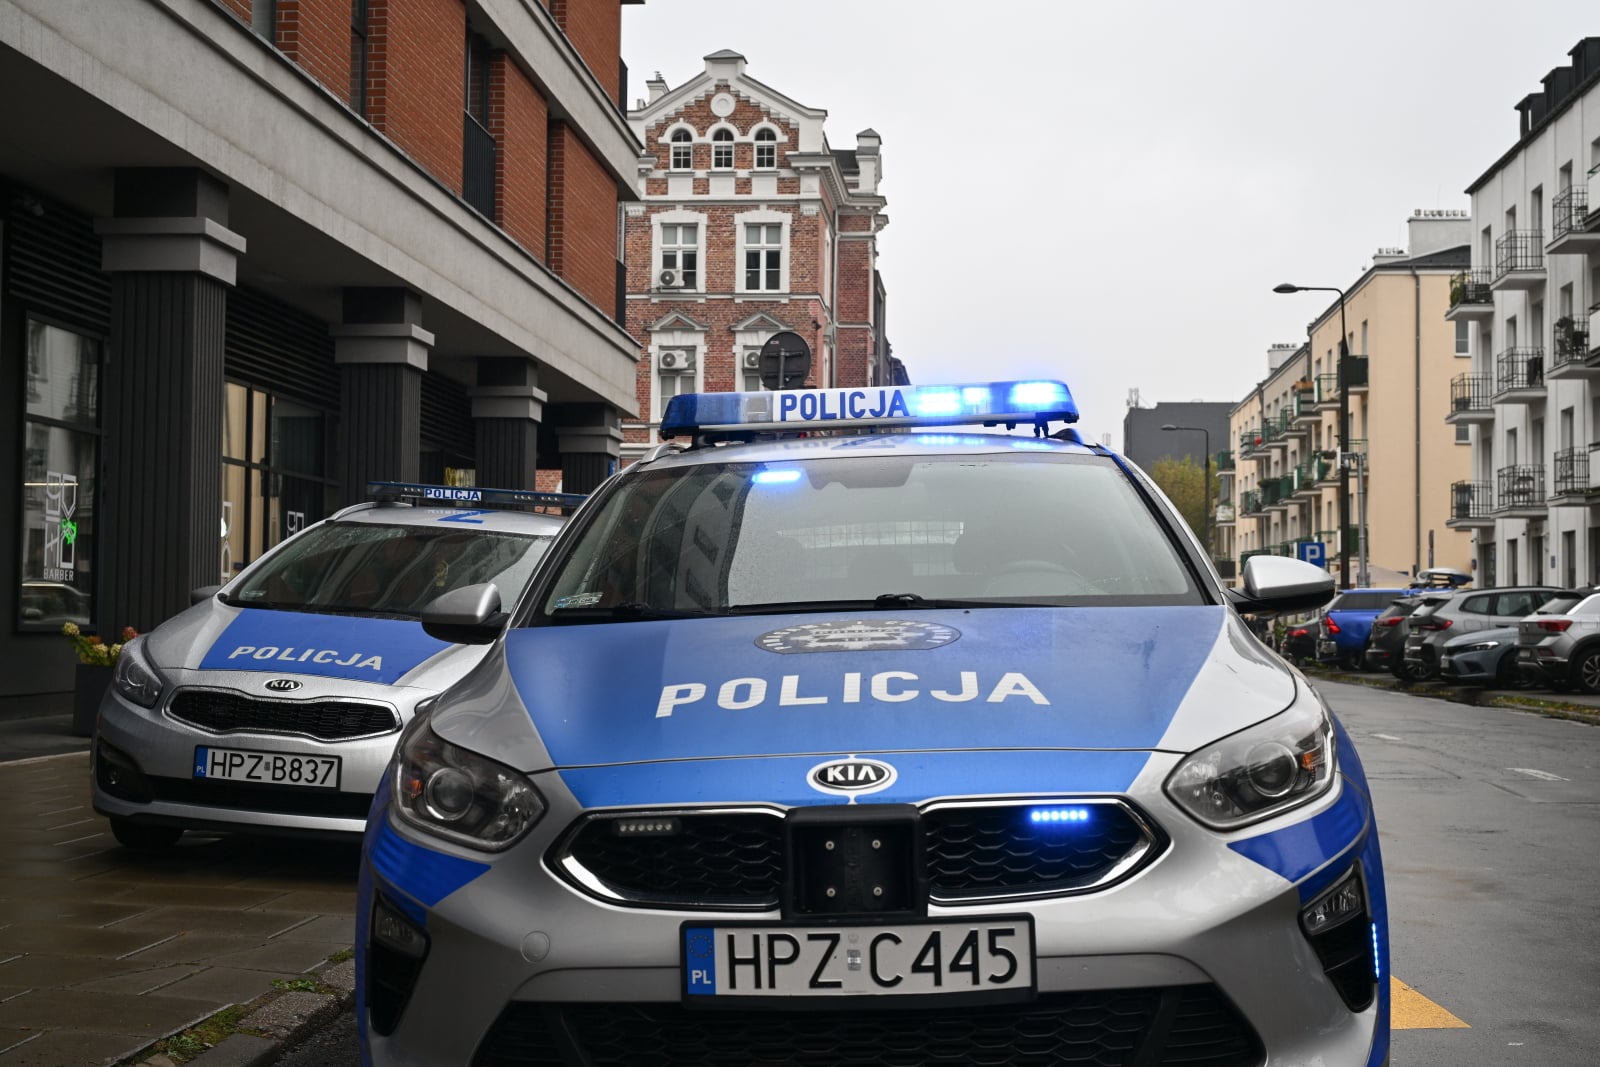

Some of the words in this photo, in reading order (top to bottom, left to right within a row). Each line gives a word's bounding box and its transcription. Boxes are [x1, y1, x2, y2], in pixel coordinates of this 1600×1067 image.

[780, 389, 910, 421] POLICJA
[424, 488, 480, 501] POLICJA
[1305, 544, 1321, 563] P
[43, 567, 75, 581] BARBER
[228, 646, 383, 671] POLICJA
[270, 680, 295, 689] KIA
[655, 671, 1051, 719] POLICJA
[196, 765, 206, 774] PL
[210, 751, 264, 780] HPZ
[271, 756, 335, 785] B837
[826, 764, 878, 782] KIA
[691, 969, 712, 985] PL
[727, 932, 843, 989] HPZ
[869, 927, 1018, 988] C445
